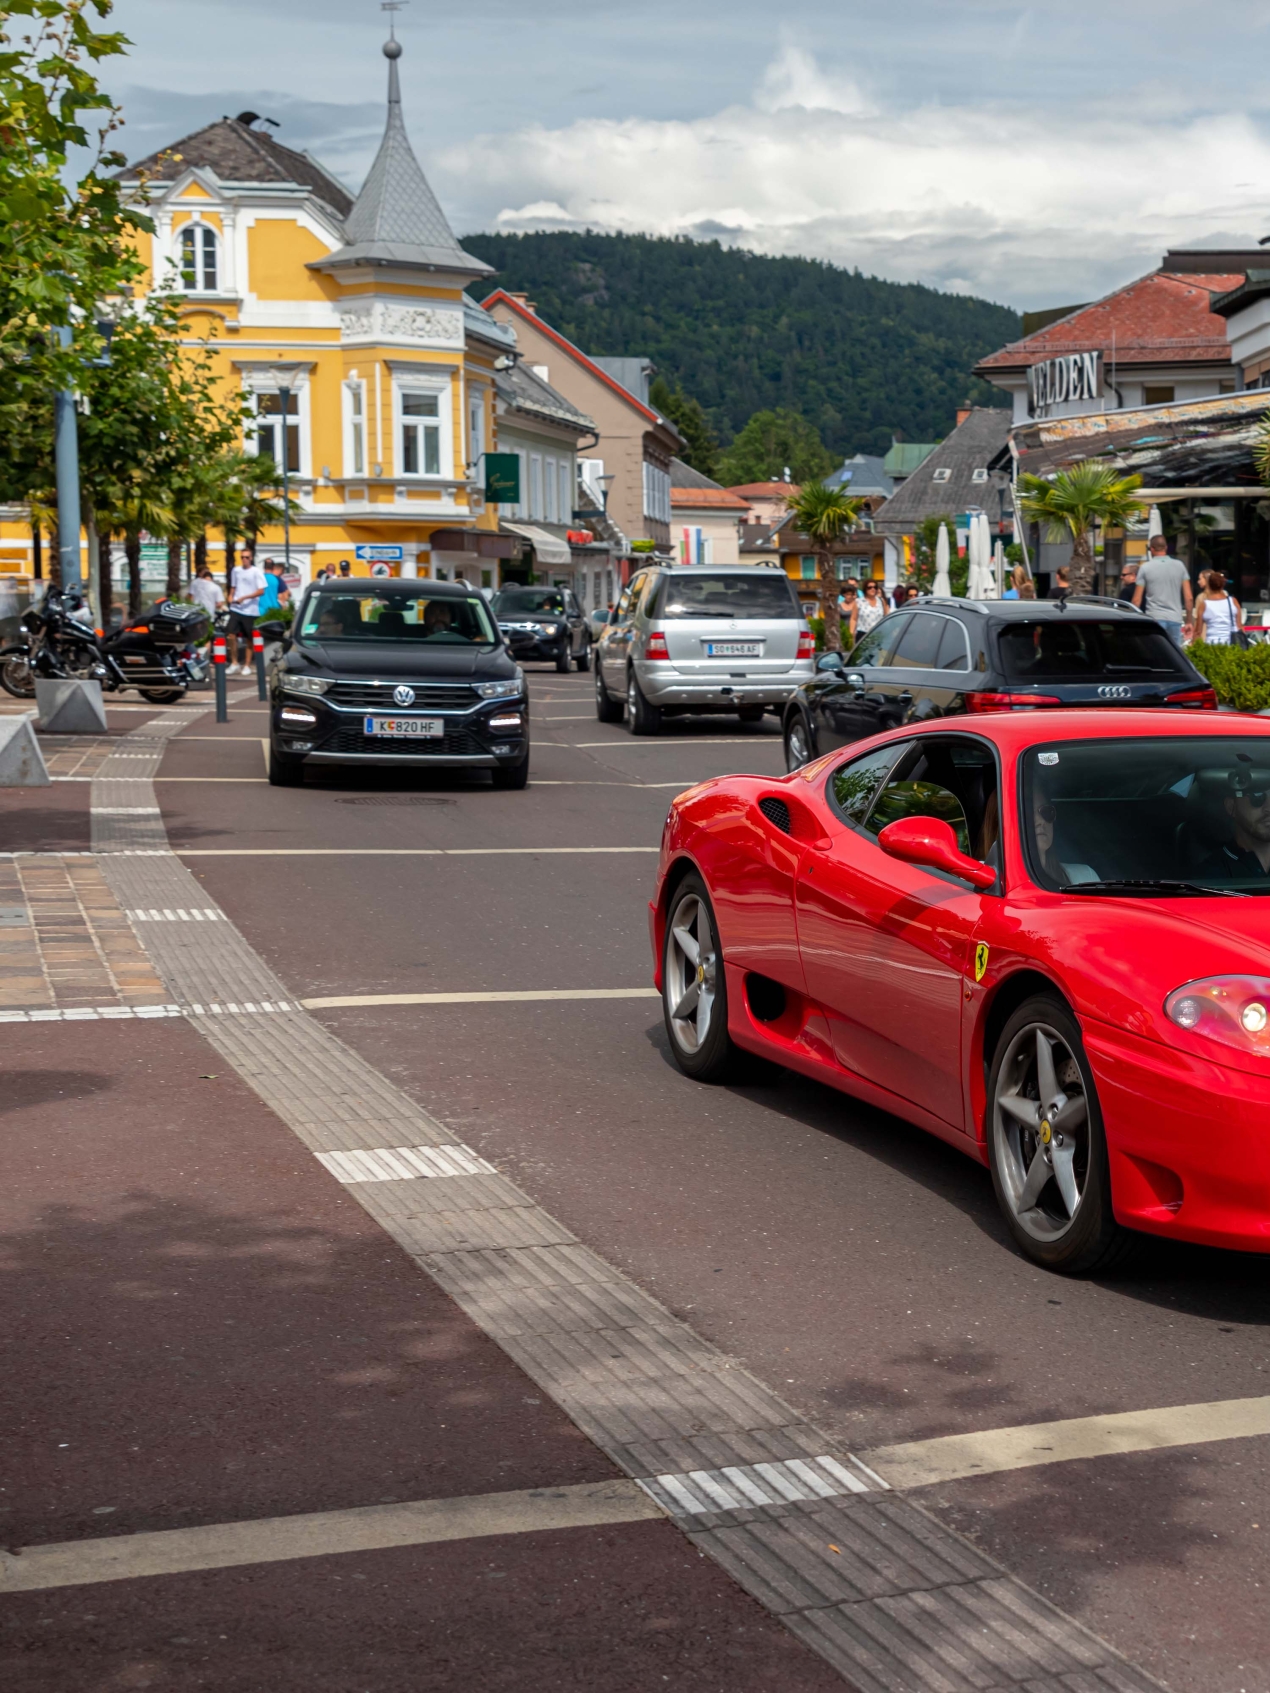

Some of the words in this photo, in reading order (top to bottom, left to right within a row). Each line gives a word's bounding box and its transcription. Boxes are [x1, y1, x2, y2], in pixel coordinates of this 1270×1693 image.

[1031, 350, 1099, 407] VELDEN
[747, 645, 756, 653] AF
[379, 721, 388, 732] K
[395, 721, 419, 733] 820
[420, 721, 436, 733] HF
